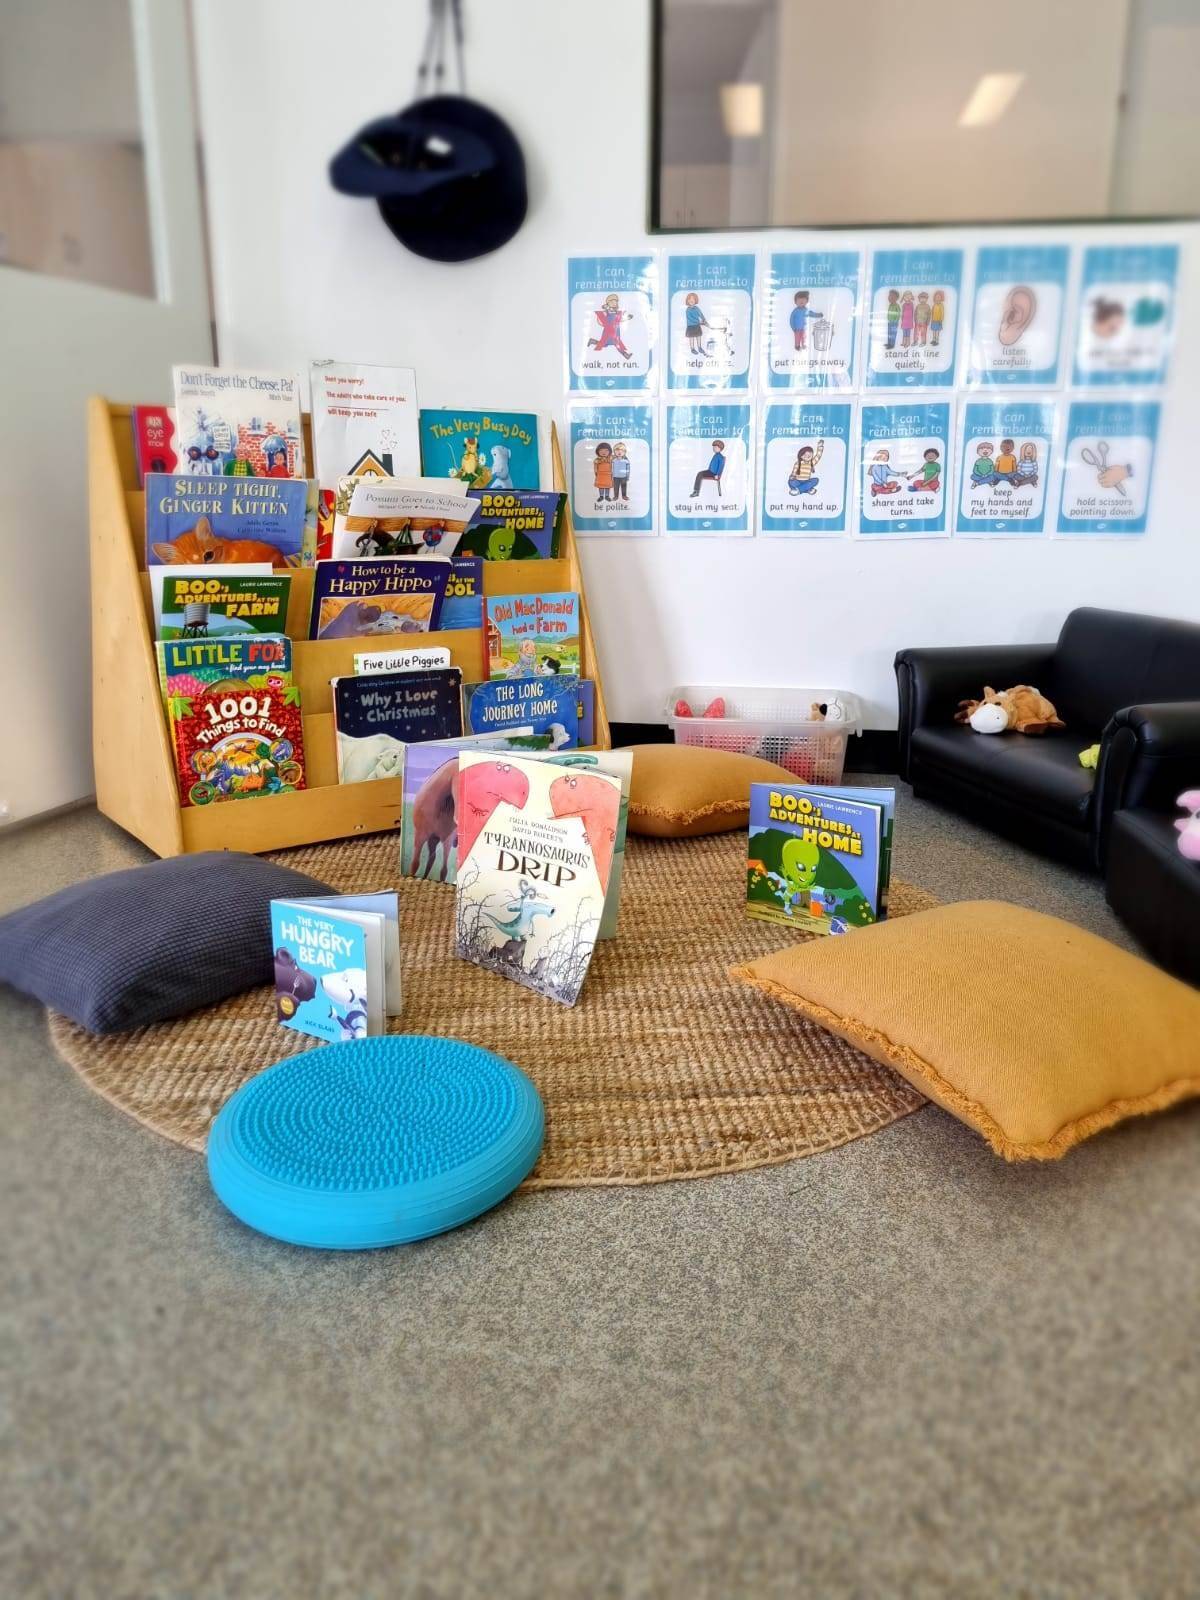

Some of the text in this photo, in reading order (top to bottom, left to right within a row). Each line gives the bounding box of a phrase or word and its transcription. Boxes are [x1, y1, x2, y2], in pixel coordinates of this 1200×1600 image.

[596, 265, 624, 276] I can
[706, 266, 726, 274] can
[809, 263, 830, 272] can
[913, 262, 933, 270] can
[676, 277, 747, 287] remember to
[779, 274, 837, 286] remember
[880, 273, 938, 282] remember
[576, 279, 629, 289] remember
[885, 350, 908, 358] stand
[582, 360, 603, 369] walk,
[686, 360, 703, 368] help
[775, 359, 789, 368] put
[181, 371, 203, 386] Don't
[205, 373, 229, 390] Forget
[232, 375, 247, 388] the
[281, 379, 293, 392] Pa!
[606, 417, 626, 425] can
[703, 416, 722, 424] can
[803, 415, 824, 423] can
[900, 415, 920, 424] can
[1005, 413, 1024, 422] can
[147, 428, 164, 440] eye
[430, 417, 532, 445] The Very Busy Day
[578, 426, 646, 436] remember to
[674, 425, 743, 435] remember to
[772, 424, 844, 435] remember to
[869, 424, 942, 436] remember to
[972, 424, 1046, 435] remember to
[994, 488, 1012, 497] keep
[160, 497, 289, 516] GINGER KITTEN
[438, 498, 468, 509] School
[606, 503, 630, 512] polite.
[675, 503, 692, 512] stay
[706, 504, 718, 512] my
[721, 503, 739, 511] seat.
[770, 502, 838, 512] put my hand up.
[872, 497, 934, 507] share and take
[971, 497, 1033, 508] my hands and
[1077, 498, 1096, 506] hold
[481, 508, 539, 516] ADVENTURES
[890, 508, 914, 516] turns.
[971, 508, 986, 517] feet
[990, 508, 998, 516] to
[1070, 508, 1106, 517] pointing
[505, 517, 544, 530] HOME
[352, 564, 415, 576] How to be a
[329, 578, 379, 594] Happy
[385, 574, 432, 592] Hippo
[445, 585, 475, 596] OOL
[174, 593, 257, 604] ADVENTURES
[226, 603, 280, 617] FARM
[494, 597, 574, 622] Old MacDonald
[512, 623, 527, 635] had
[536, 617, 567, 633] Farm
[172, 644, 242, 666] LITTLE
[364, 655, 444, 670] Five Little Piggies
[518, 683, 544, 699] LONG
[361, 690, 438, 708] Why I Love
[204, 697, 272, 724] 1001
[367, 705, 436, 722] Christmas
[196, 717, 286, 743] Things to Find
[835, 806, 862, 816] LAWRENCE
[769, 809, 852, 834] ADVENTURES
[802, 828, 862, 856] HOME
[484, 832, 590, 868] TYRANNOSAURUS
[496, 850, 577, 888] DRIP
[296, 916, 335, 931] THE VERY
[281, 921, 354, 957] HUNGRY
[300, 946, 336, 970] BEAR
